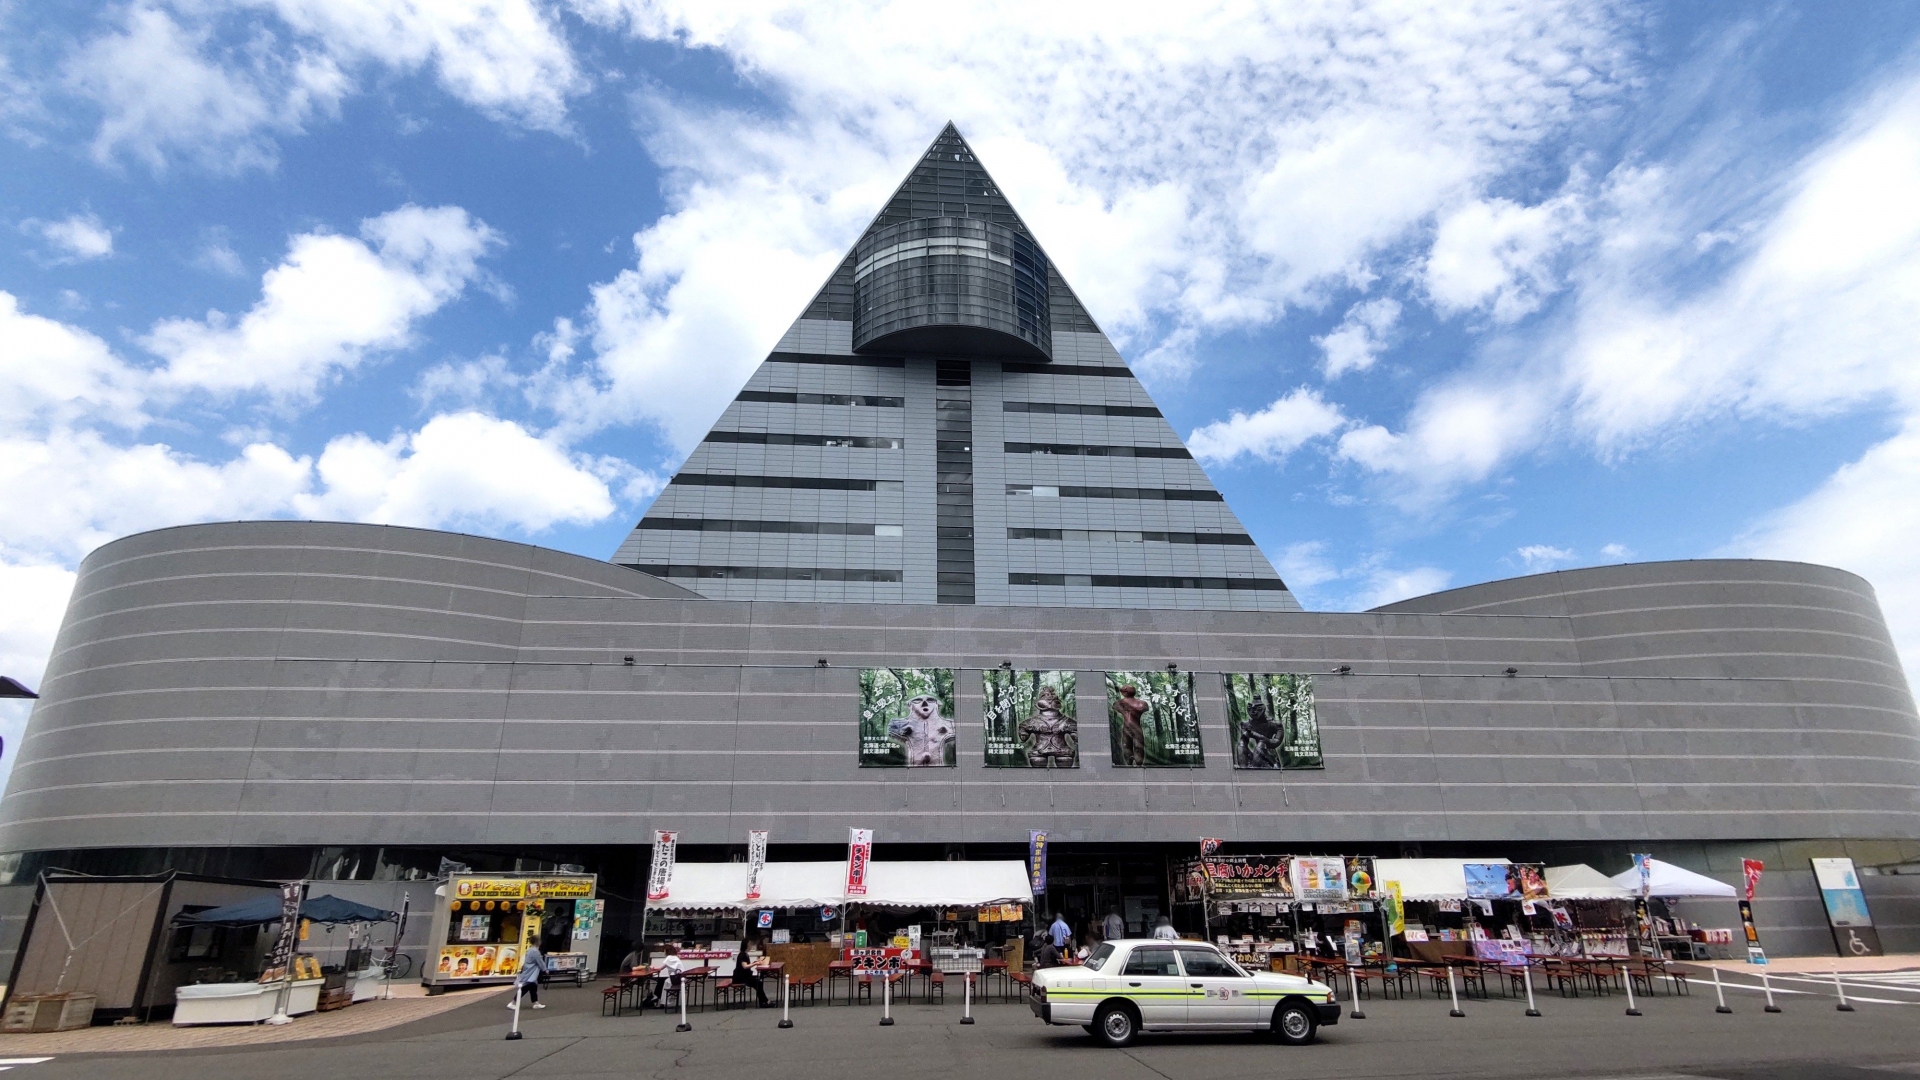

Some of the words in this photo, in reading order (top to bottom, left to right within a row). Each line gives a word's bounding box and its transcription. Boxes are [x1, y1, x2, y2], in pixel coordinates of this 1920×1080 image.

[656, 843, 669, 893] たこの唐揚げ
